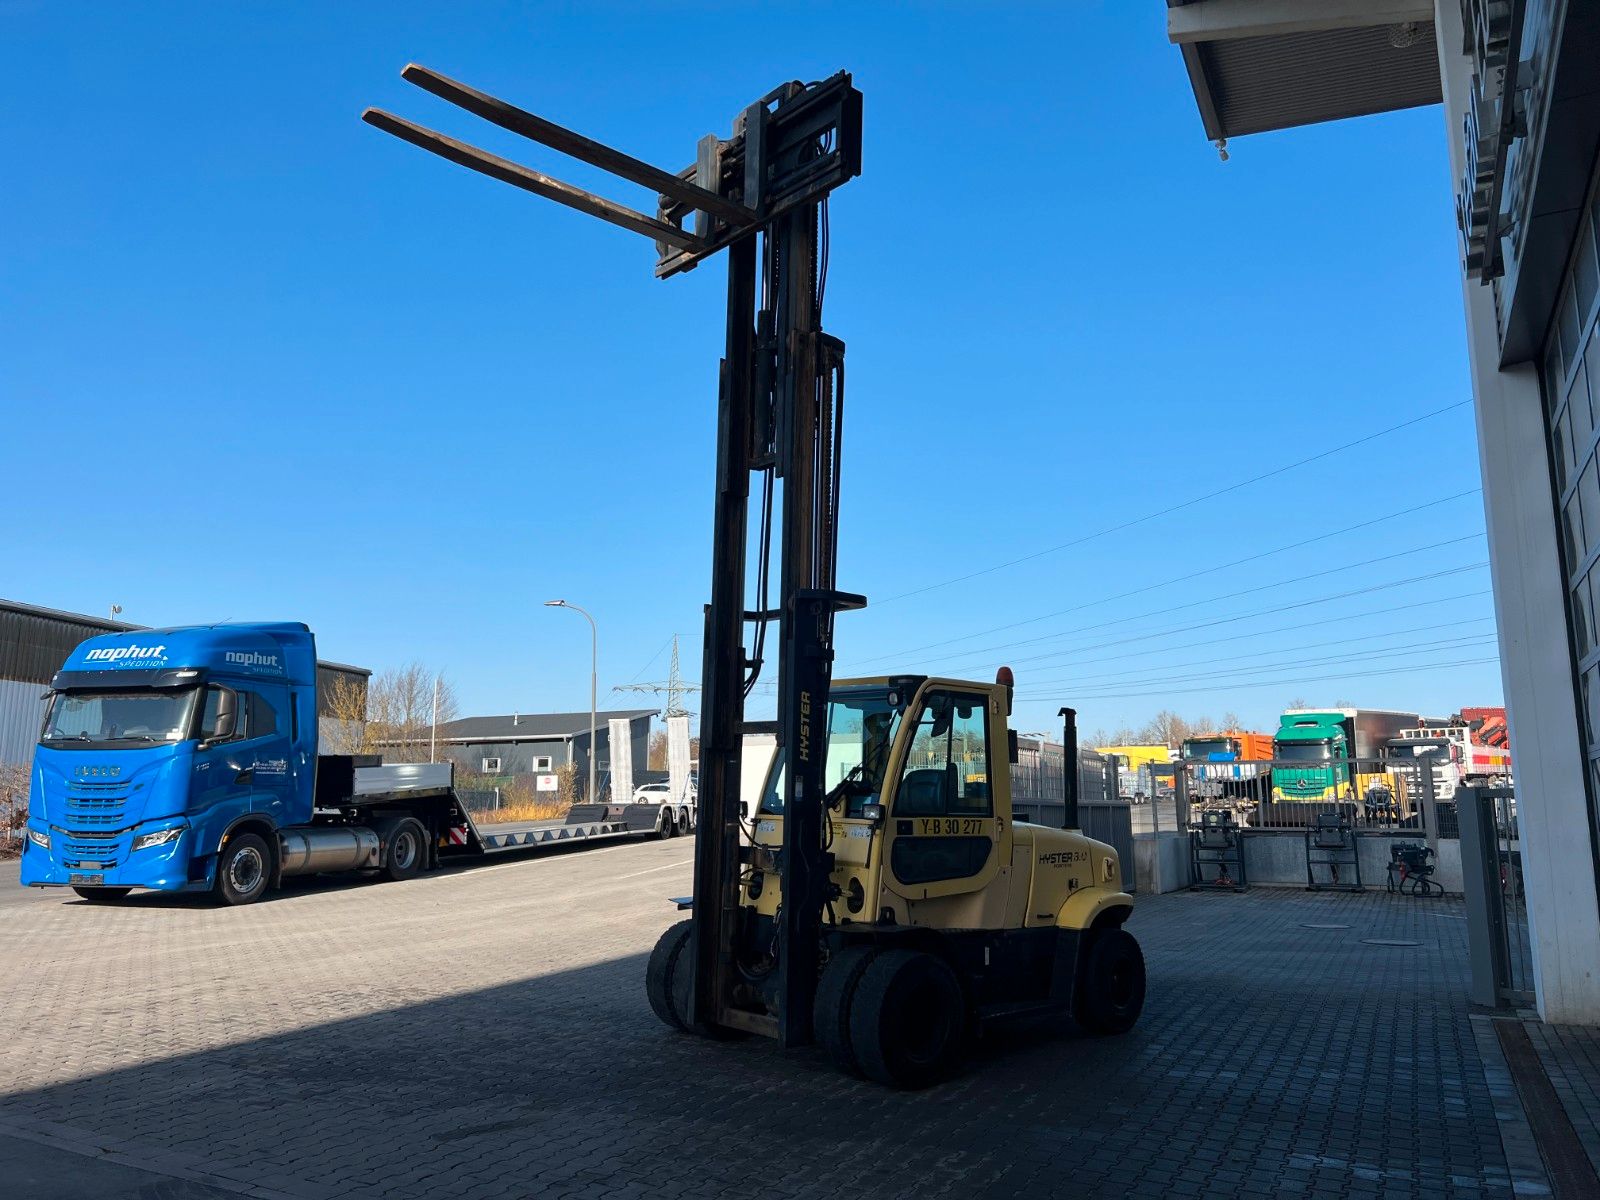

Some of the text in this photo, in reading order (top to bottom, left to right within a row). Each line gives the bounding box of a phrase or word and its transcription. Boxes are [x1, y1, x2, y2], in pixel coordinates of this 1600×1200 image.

[85, 644, 166, 662] nophut
[225, 651, 278, 667] nophut
[800, 691, 811, 761] HYSTER
[945, 819, 960, 835] 30
[963, 819, 983, 835] 277
[1039, 852, 1073, 864] HYSTER
